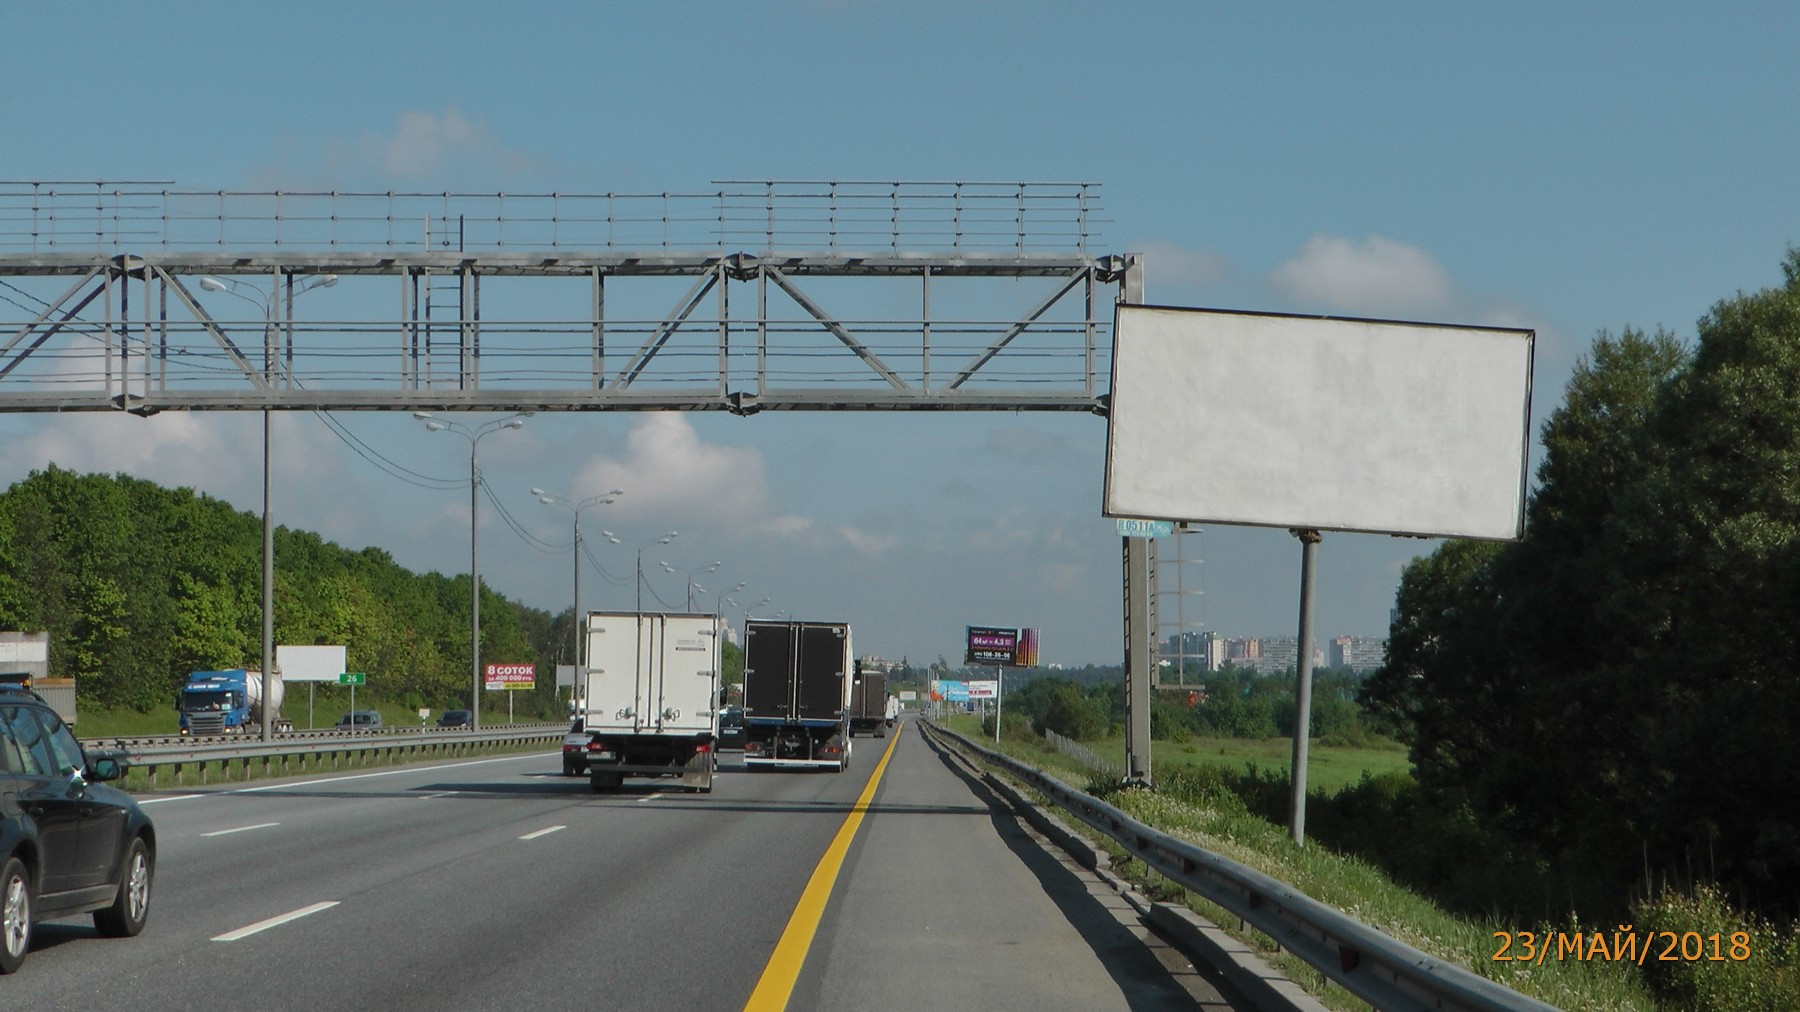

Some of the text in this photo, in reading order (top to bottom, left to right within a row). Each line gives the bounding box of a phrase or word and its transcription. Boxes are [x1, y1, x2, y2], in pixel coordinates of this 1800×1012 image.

[488, 665, 533, 675] 8 СОТОК
[347, 675, 357, 683] 26
